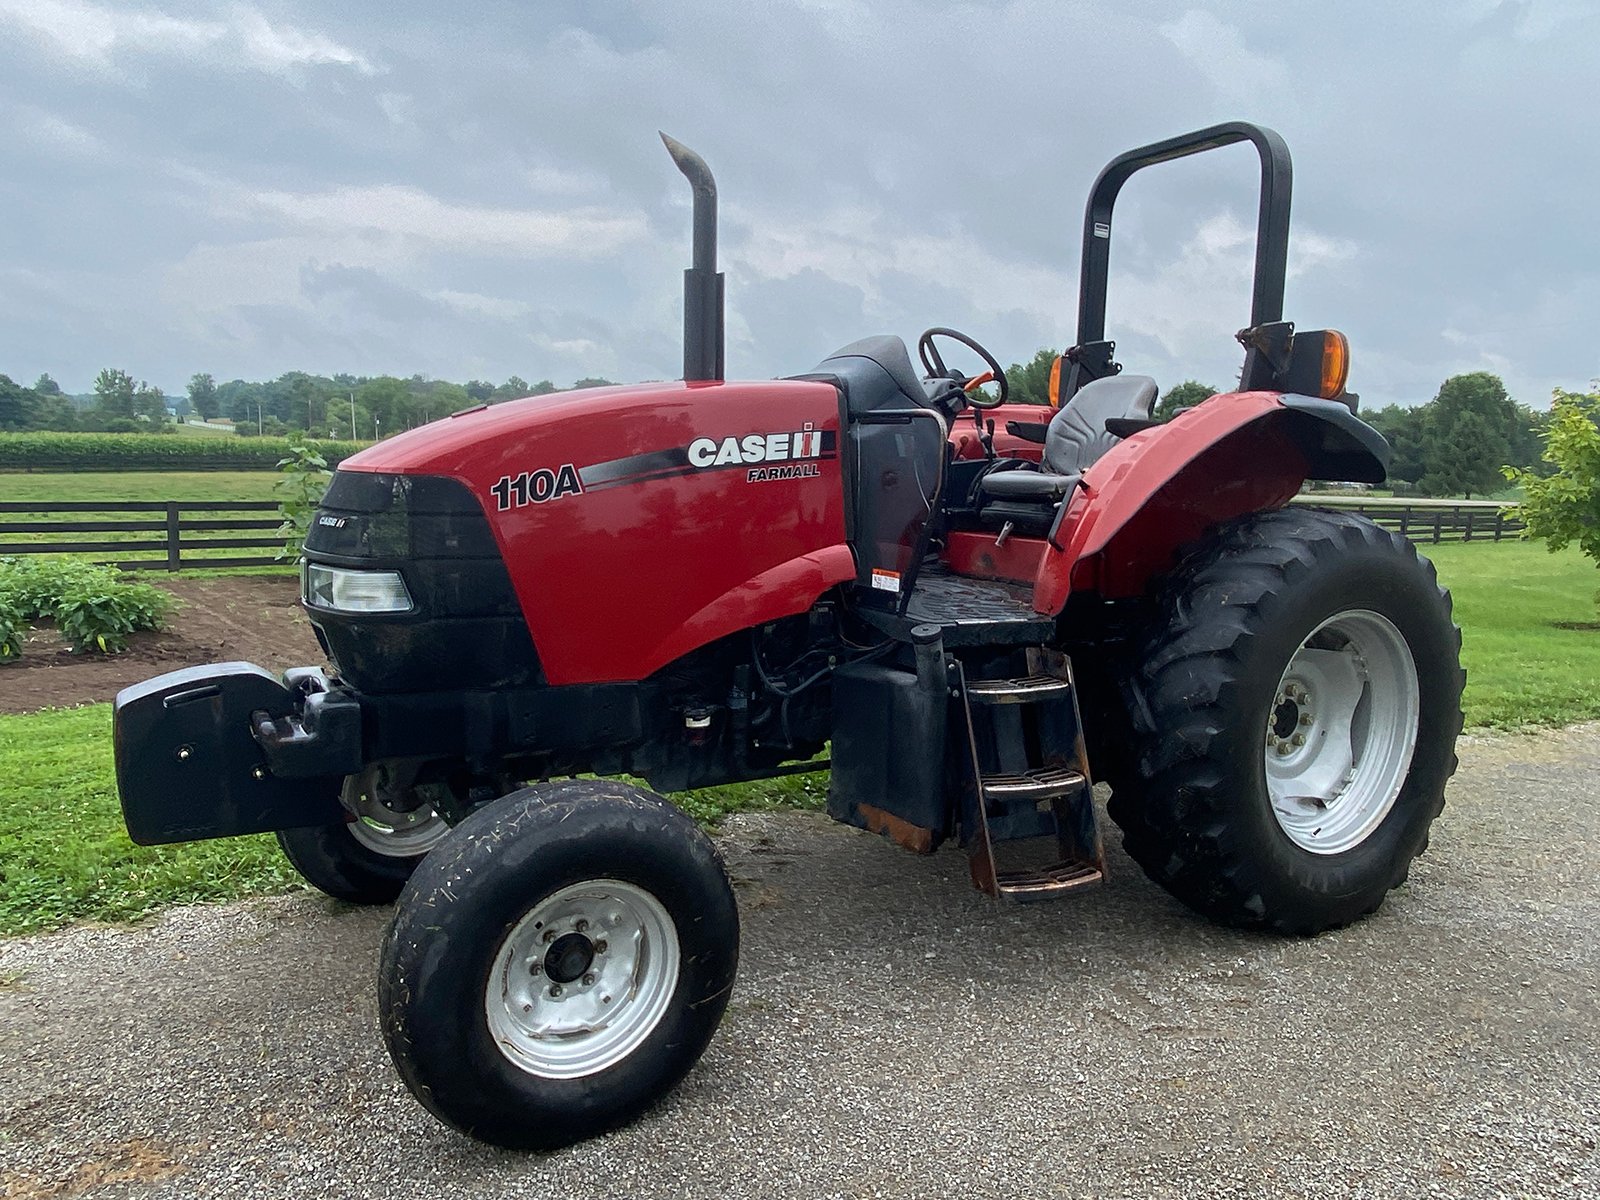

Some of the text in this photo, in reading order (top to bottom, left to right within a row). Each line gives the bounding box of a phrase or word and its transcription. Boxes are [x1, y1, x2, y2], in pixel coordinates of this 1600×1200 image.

[687, 437, 790, 468] CASE
[491, 463, 583, 511] 110A
[747, 463, 820, 483] FARMALL
